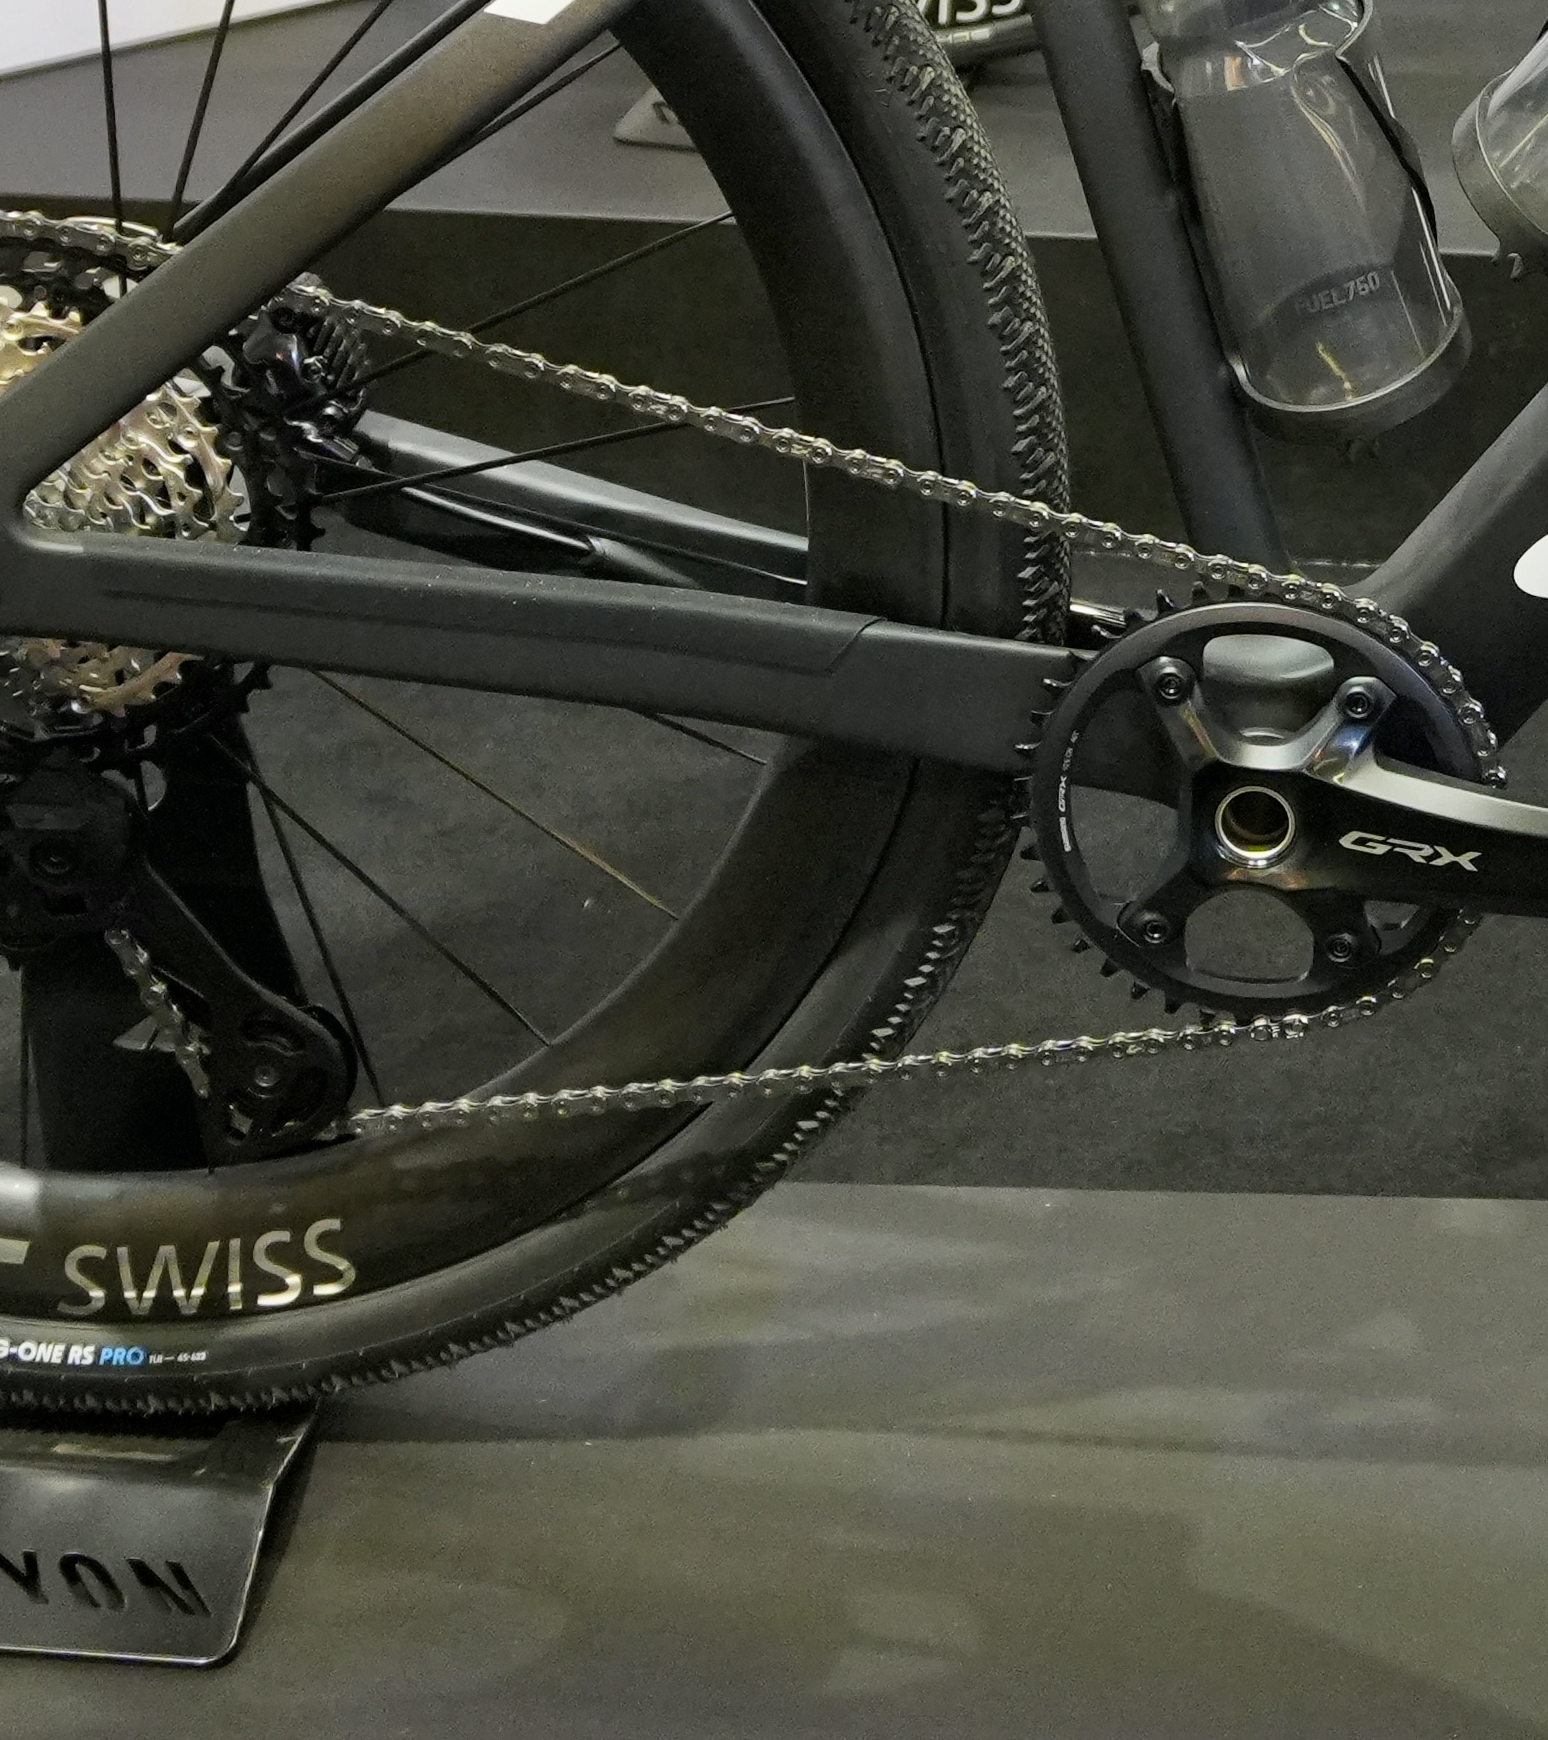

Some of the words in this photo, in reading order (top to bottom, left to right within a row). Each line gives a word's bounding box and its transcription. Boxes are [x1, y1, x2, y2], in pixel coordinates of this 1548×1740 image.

[1338, 830, 1482, 873] GRX
[54, 1217, 356, 1316] SWISS
[67, 1343, 95, 1366] RS
[100, 1345, 146, 1366] PRO
